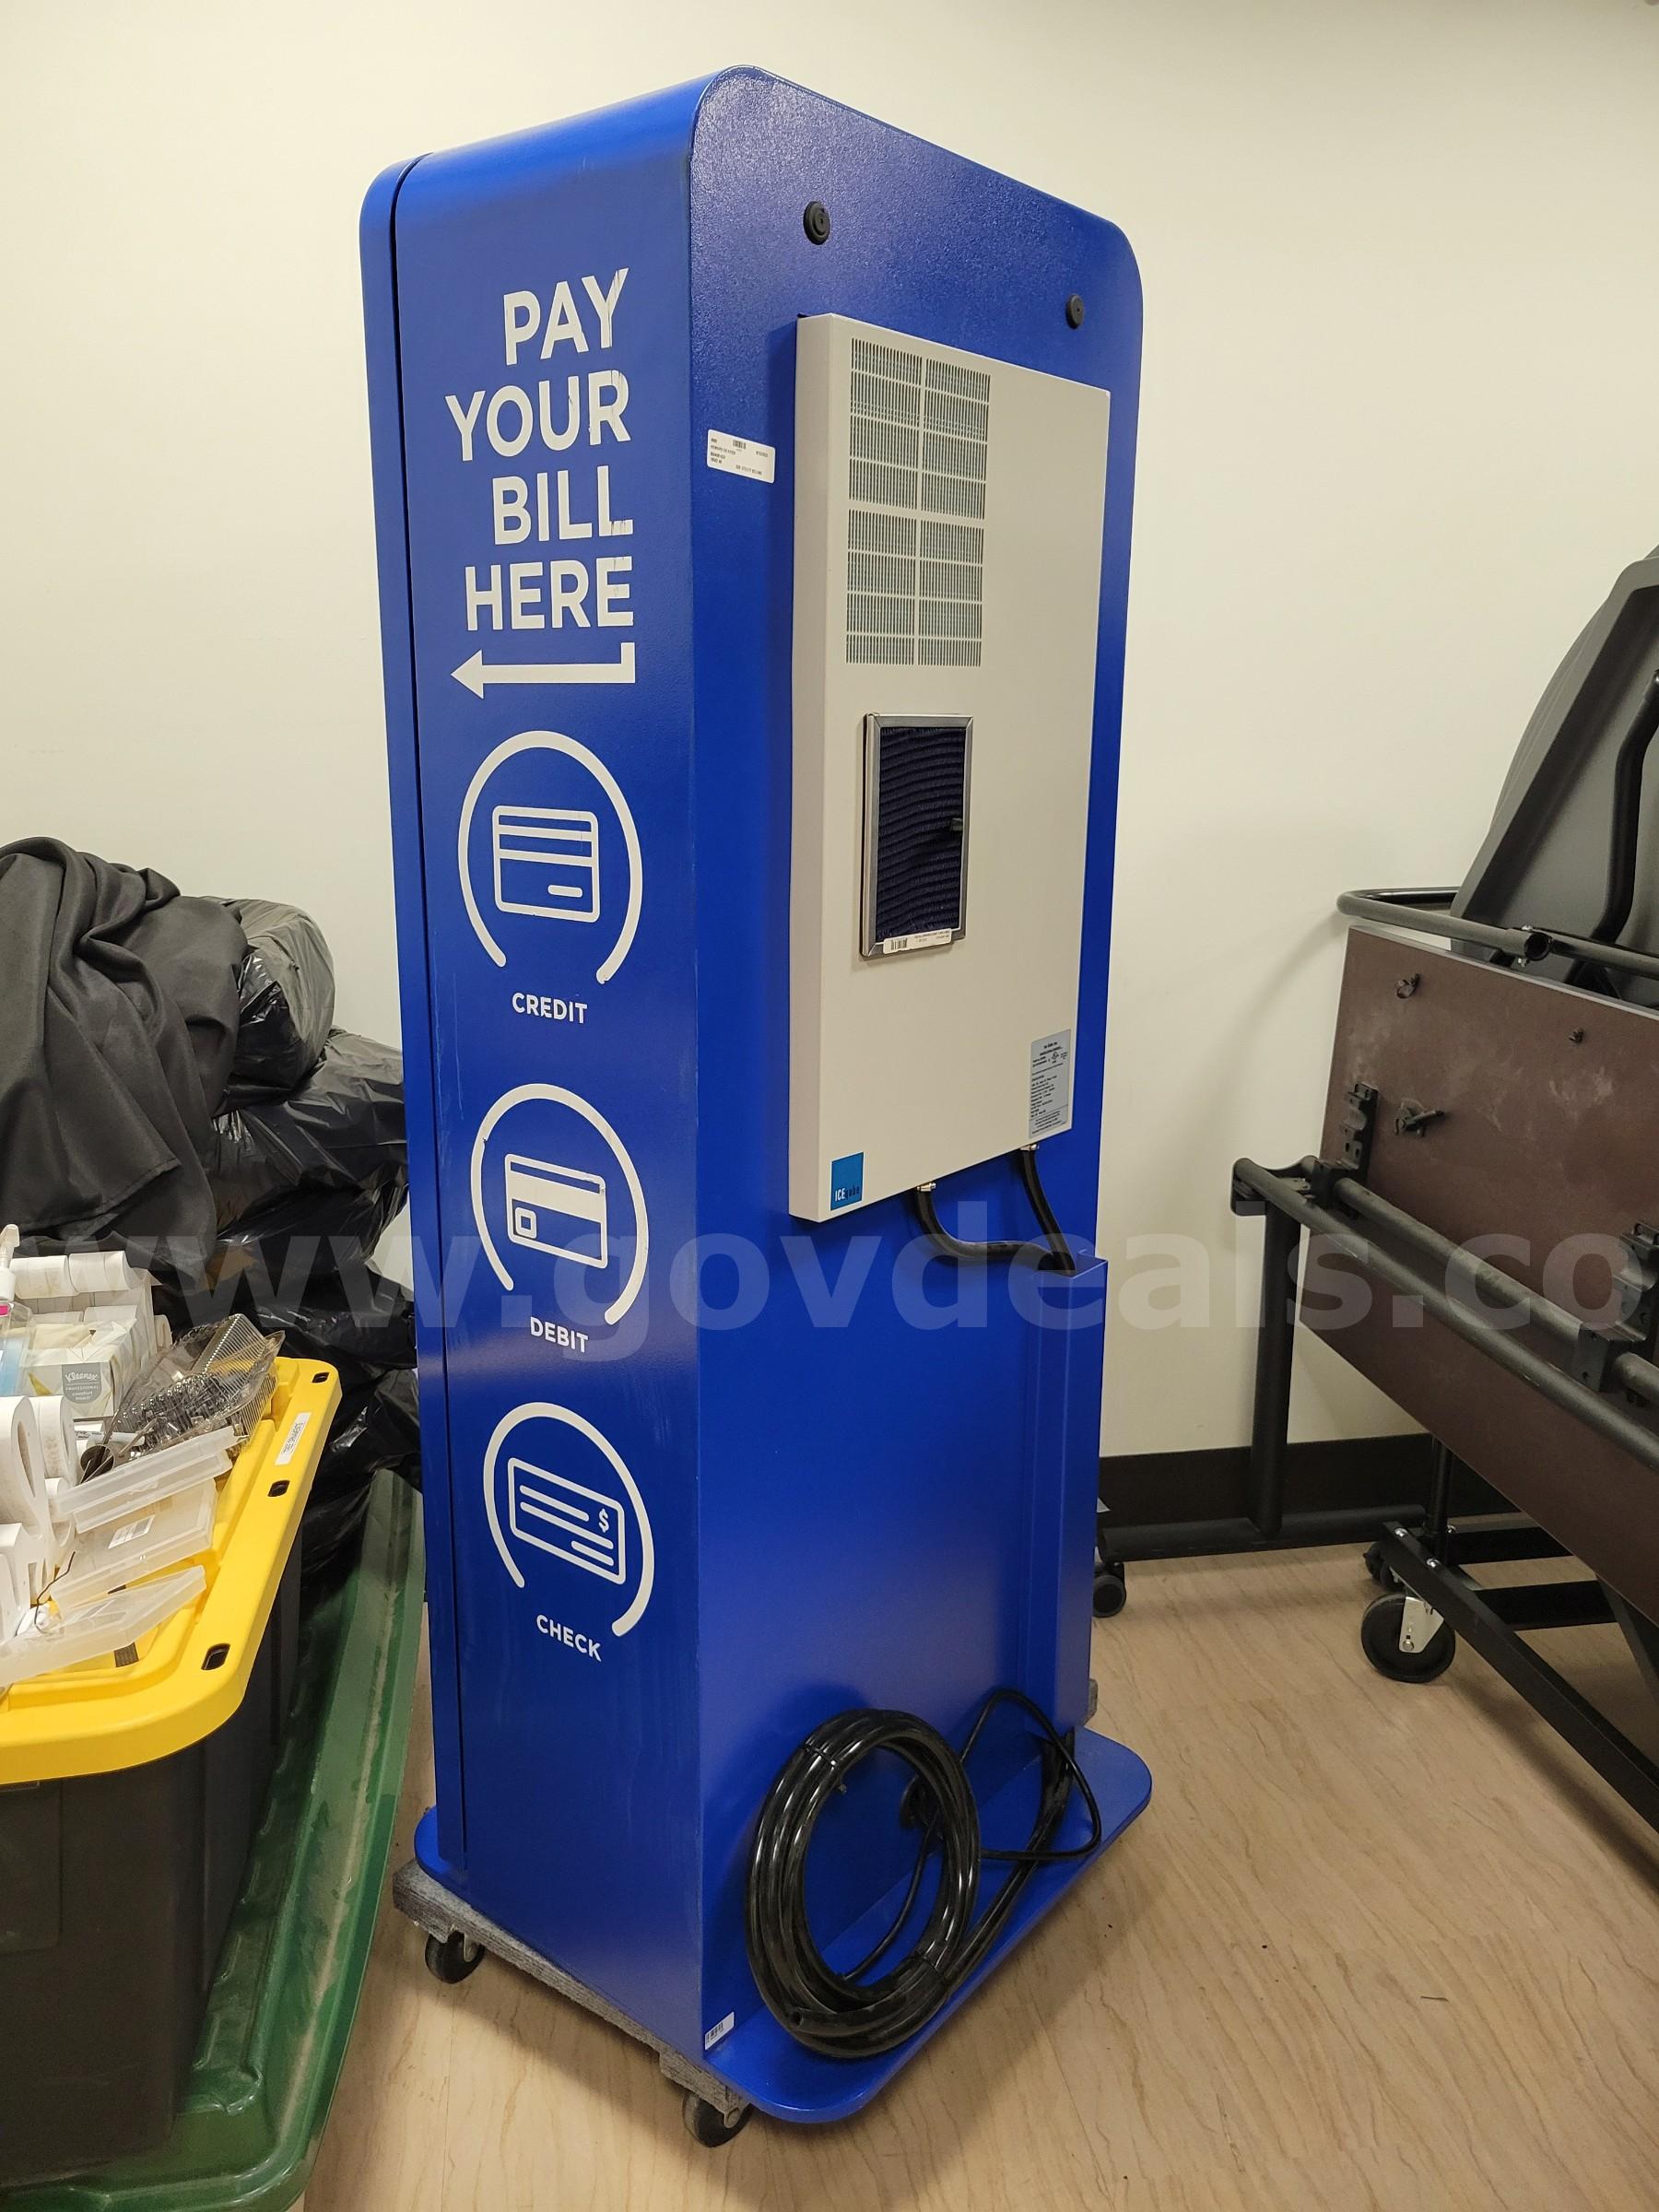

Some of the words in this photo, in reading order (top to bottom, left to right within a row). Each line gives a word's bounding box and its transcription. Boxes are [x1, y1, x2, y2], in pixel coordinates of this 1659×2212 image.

[503, 267, 629, 365] PAY
[445, 370, 631, 461] YOUR
[492, 465, 633, 545] BILL
[465, 556, 634, 630] HERE
[512, 993, 588, 1024] CREDIT
[530, 1316, 589, 1353] DEBIT
[598, 1508, 609, 1533] $
[536, 1614, 602, 1662] CHECK
